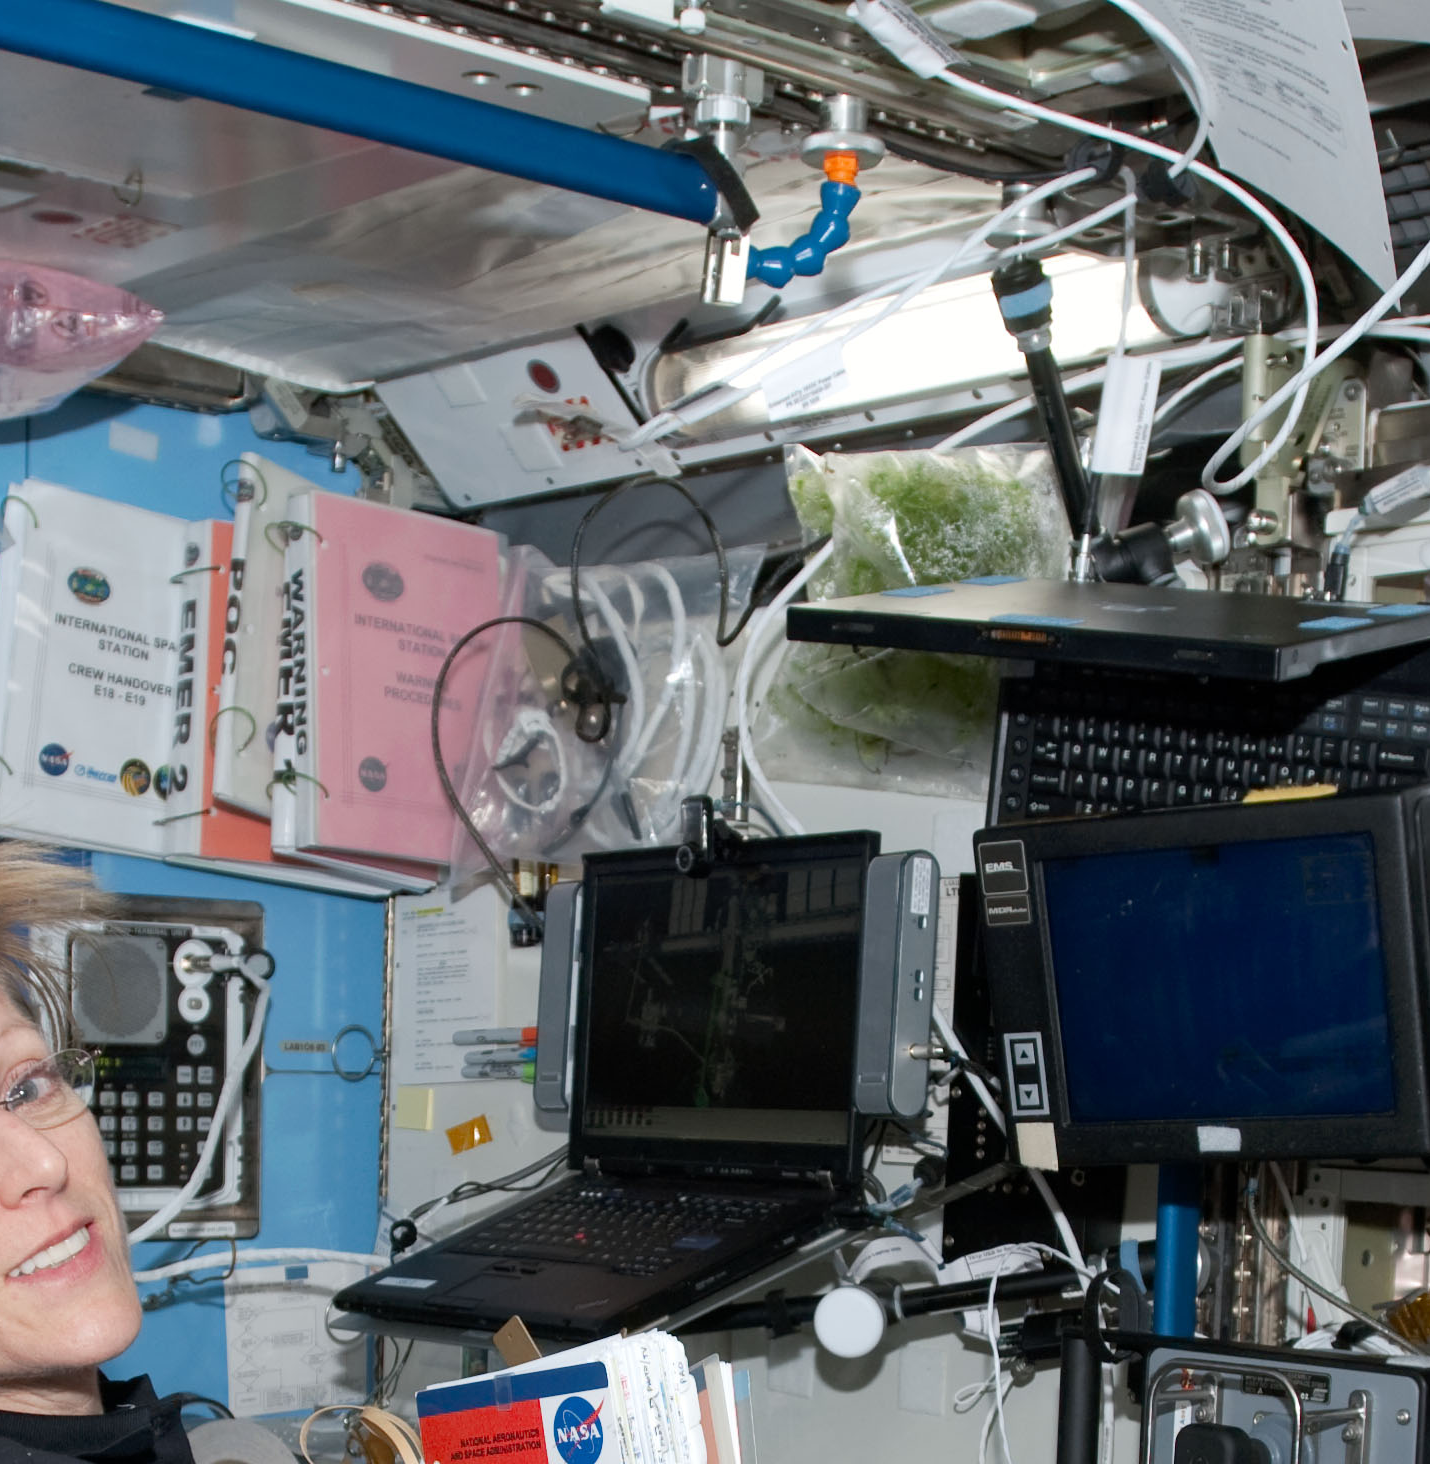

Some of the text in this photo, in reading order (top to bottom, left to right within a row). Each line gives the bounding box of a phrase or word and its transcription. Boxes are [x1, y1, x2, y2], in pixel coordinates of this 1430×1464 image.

[55, 613, 150, 646] INTERNATIONAL
[222, 558, 246, 675] POC
[354, 613, 446, 644] INTERNATIONAL
[98, 639, 149, 661] STATION
[291, 567, 307, 756] WARNING
[68, 663, 172, 697] CREW HANDOVER
[94, 684, 146, 706] E18 E19
[167, 599, 197, 796] EMER 2
[985, 861, 1014, 874] EMS
[460, 1428, 540, 1449] NATIONAL AERONAUTICS
[556, 1423, 601, 1446] NASA
[464, 1449, 485, 1460] SPACE
[486, 1440, 542, 1457] ADMINISTRATION
